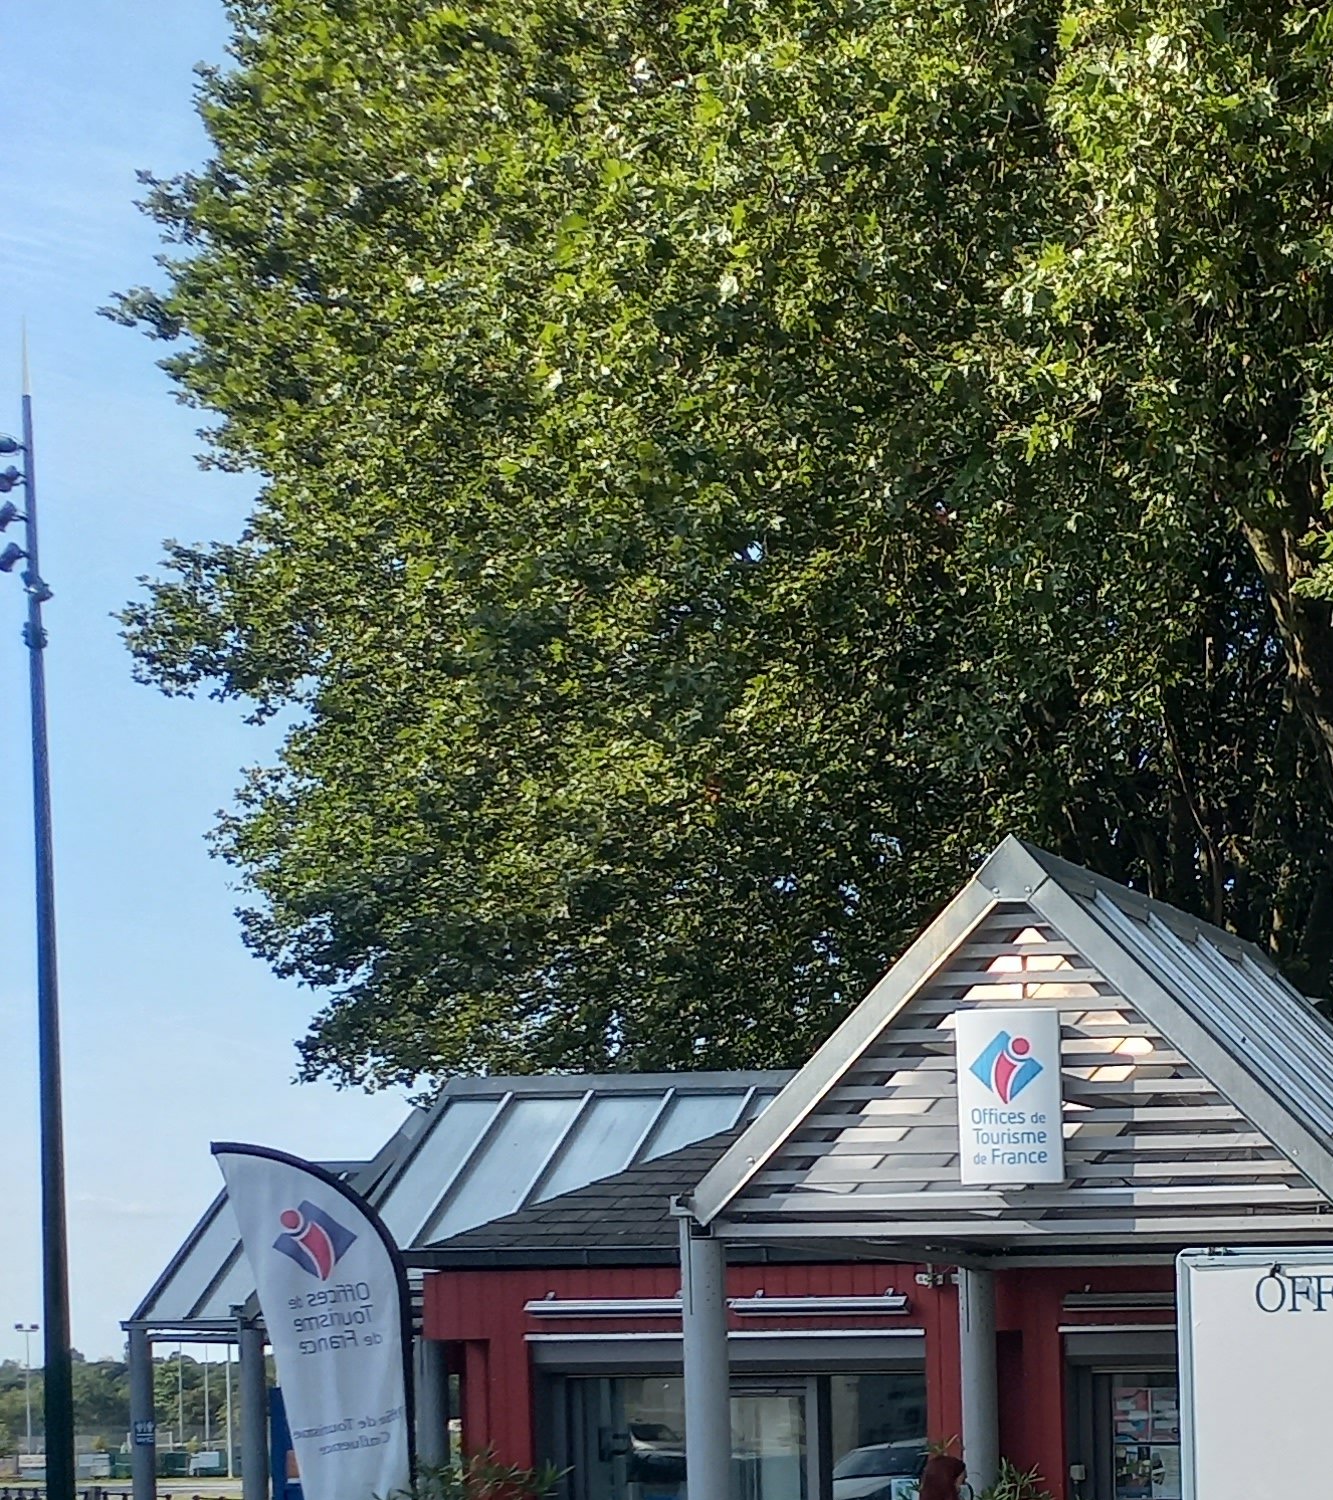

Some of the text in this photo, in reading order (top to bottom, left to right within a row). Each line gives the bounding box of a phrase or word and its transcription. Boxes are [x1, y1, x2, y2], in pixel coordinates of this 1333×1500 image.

[971, 1107, 1046, 1125] Offices de
[972, 1128, 1047, 1145] Tourisme
[973, 1148, 1048, 1165] de France
